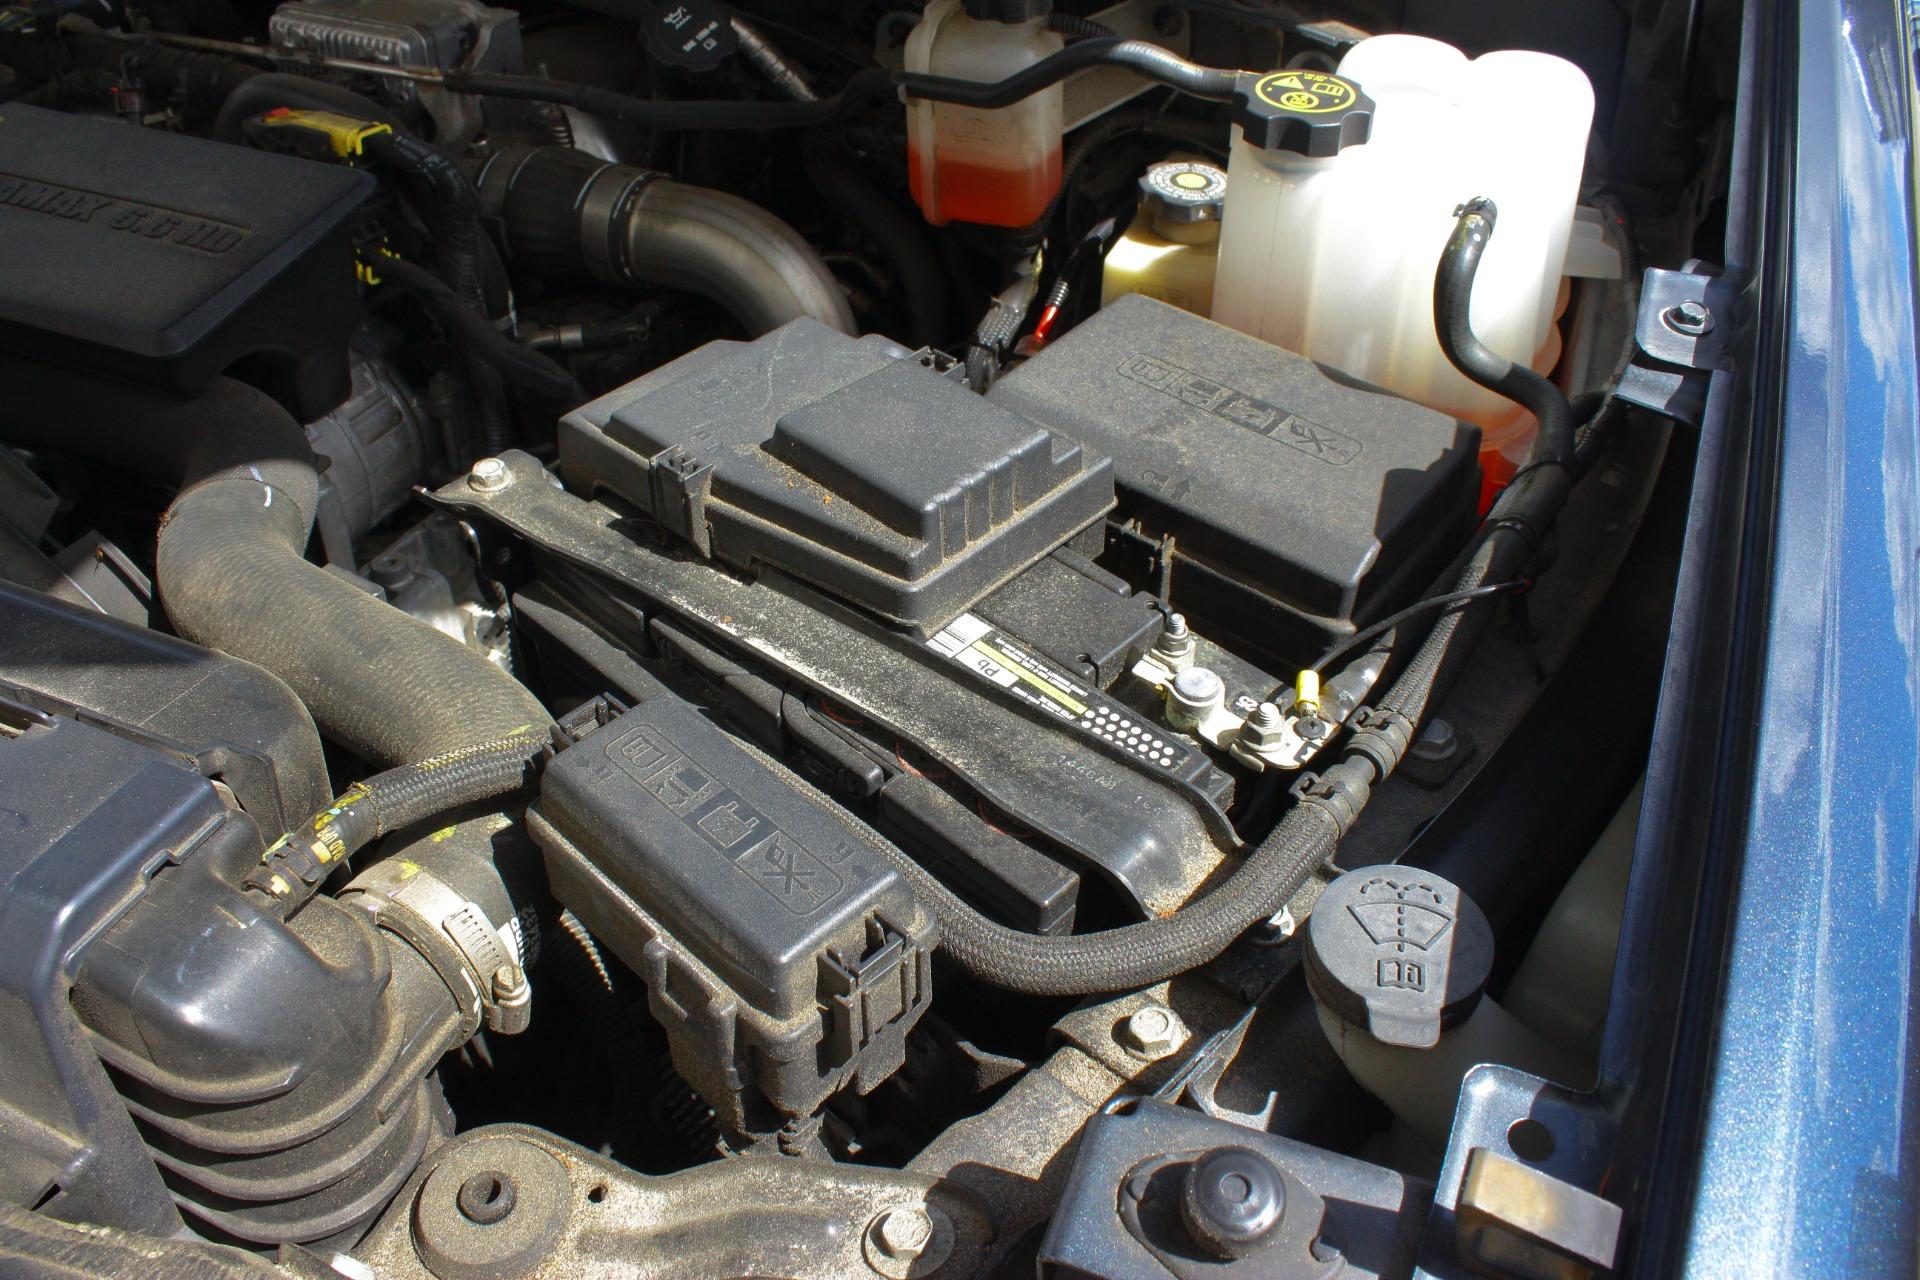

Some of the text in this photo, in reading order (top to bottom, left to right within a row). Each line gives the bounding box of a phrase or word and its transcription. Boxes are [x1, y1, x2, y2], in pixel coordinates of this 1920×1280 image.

[108, 206, 184, 239] 6.6
[174, 222, 244, 254] HD
[977, 659, 1001, 678] Pb
[316, 824, 347, 863] RAD UPR
